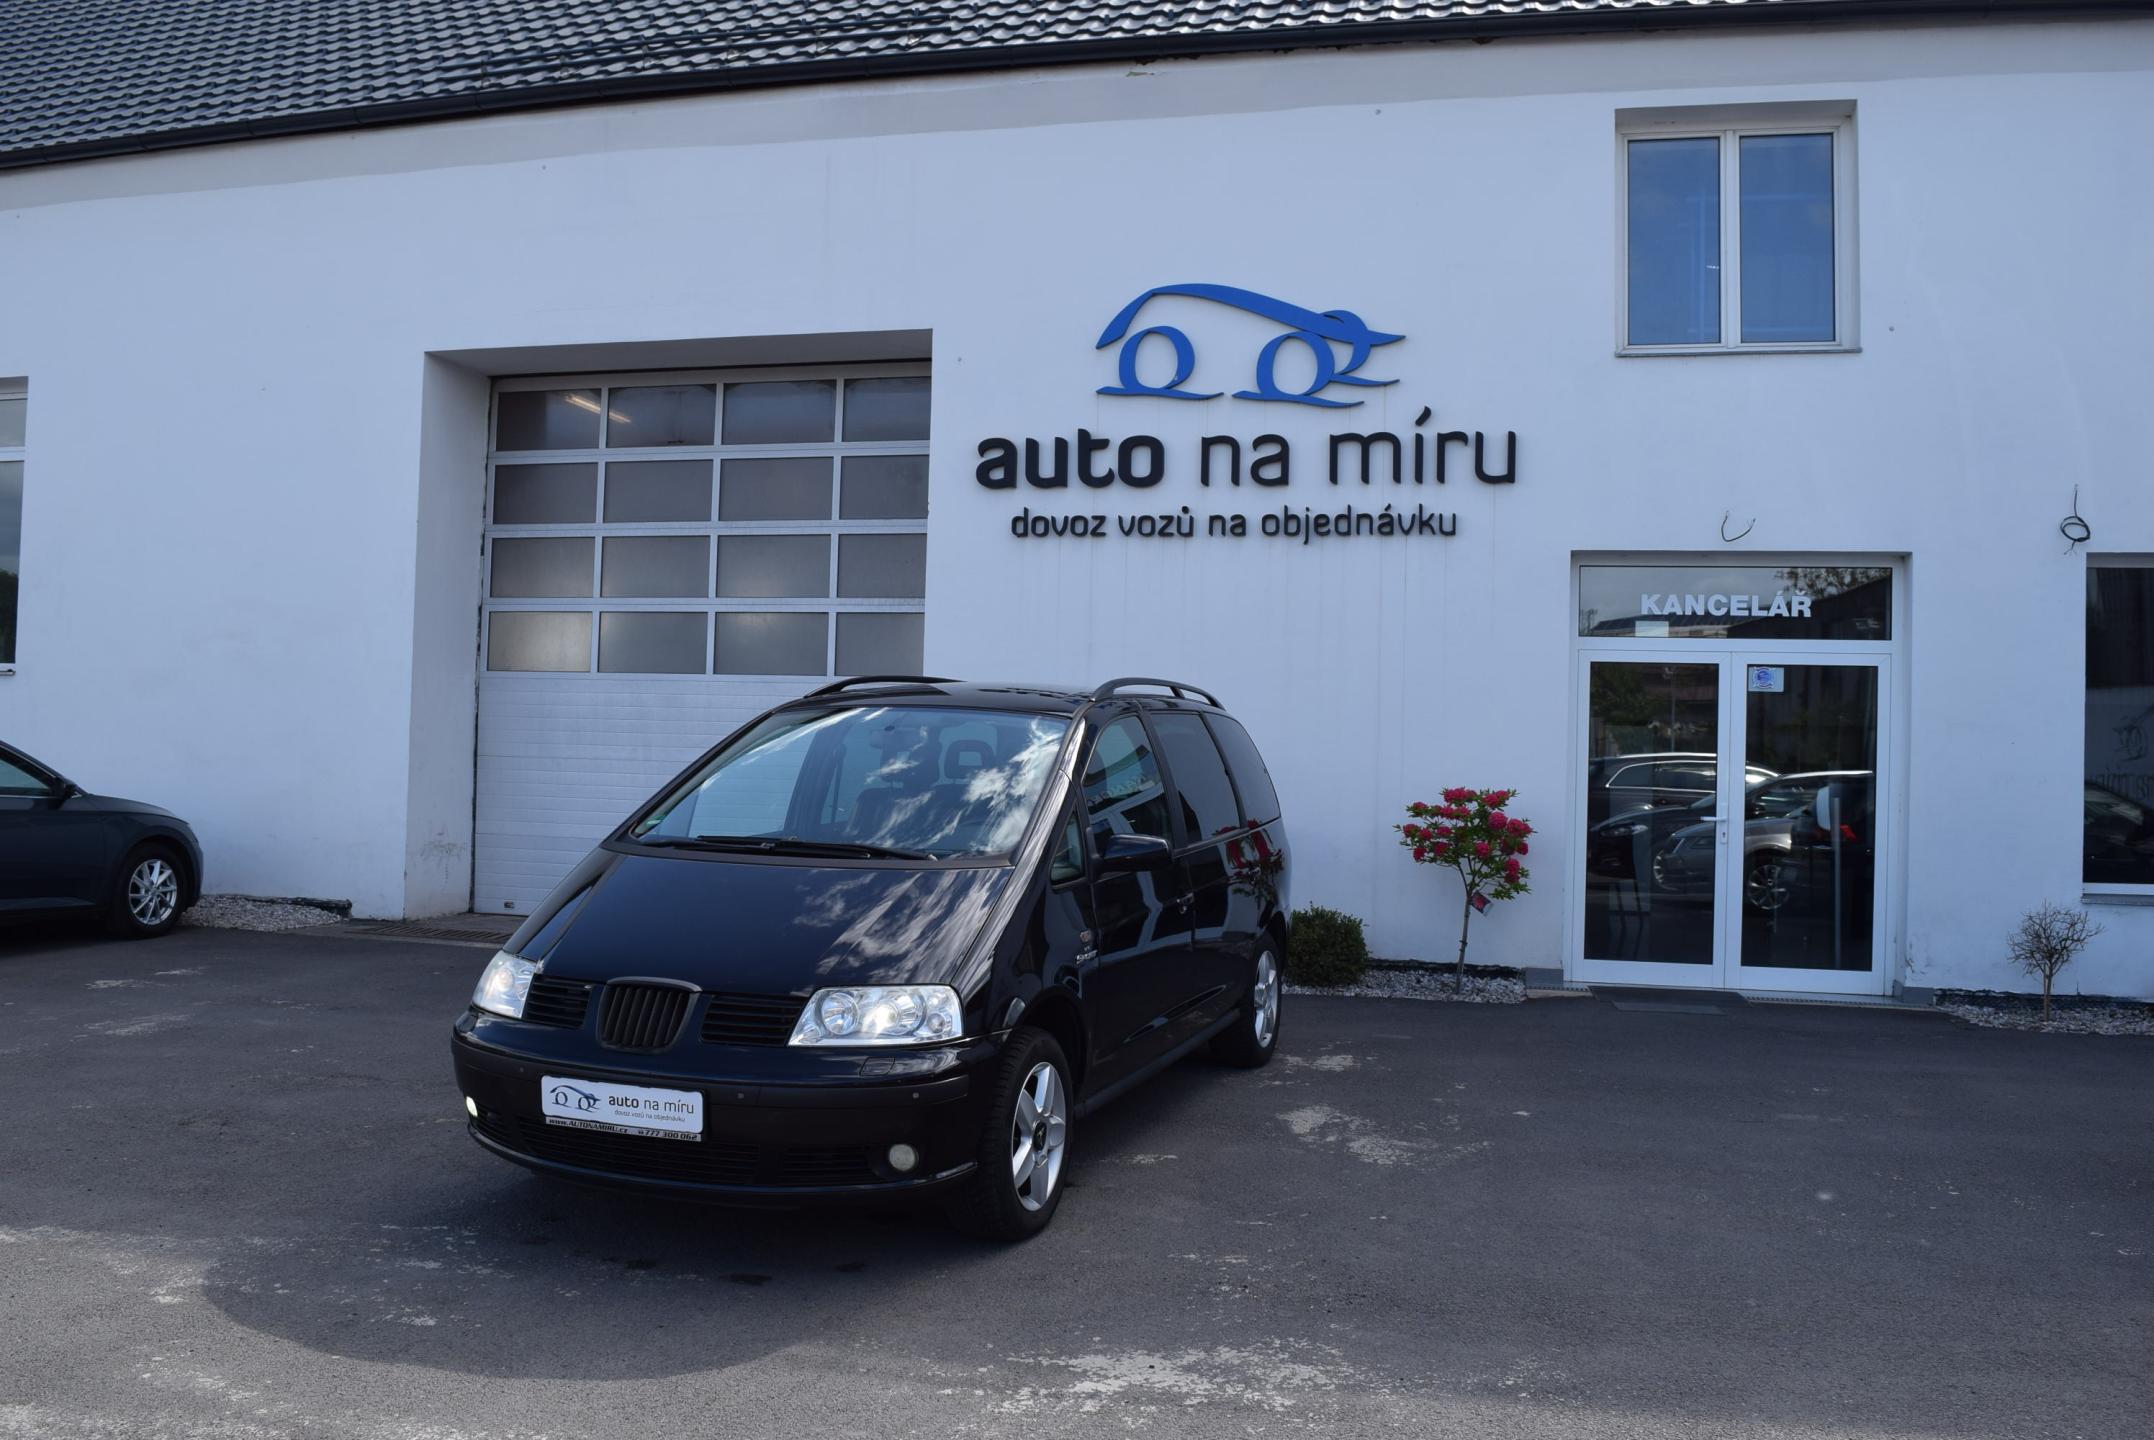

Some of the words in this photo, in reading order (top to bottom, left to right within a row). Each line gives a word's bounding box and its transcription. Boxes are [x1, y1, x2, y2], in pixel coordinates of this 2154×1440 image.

[975, 428, 1166, 488] auto
[1201, 433, 1290, 487] na
[1329, 405, 1517, 485] míru
[1011, 507, 1107, 538] dovoz
[1118, 506, 1195, 538] vozů
[1208, 514, 1247, 538] na
[1261, 503, 1457, 544] objednávku
[1640, 590, 1812, 618] KANCELÁŘ
[608, 1095, 639, 1109] auto
[644, 1099, 659, 1111] na
[664, 1099, 694, 1114] míru
